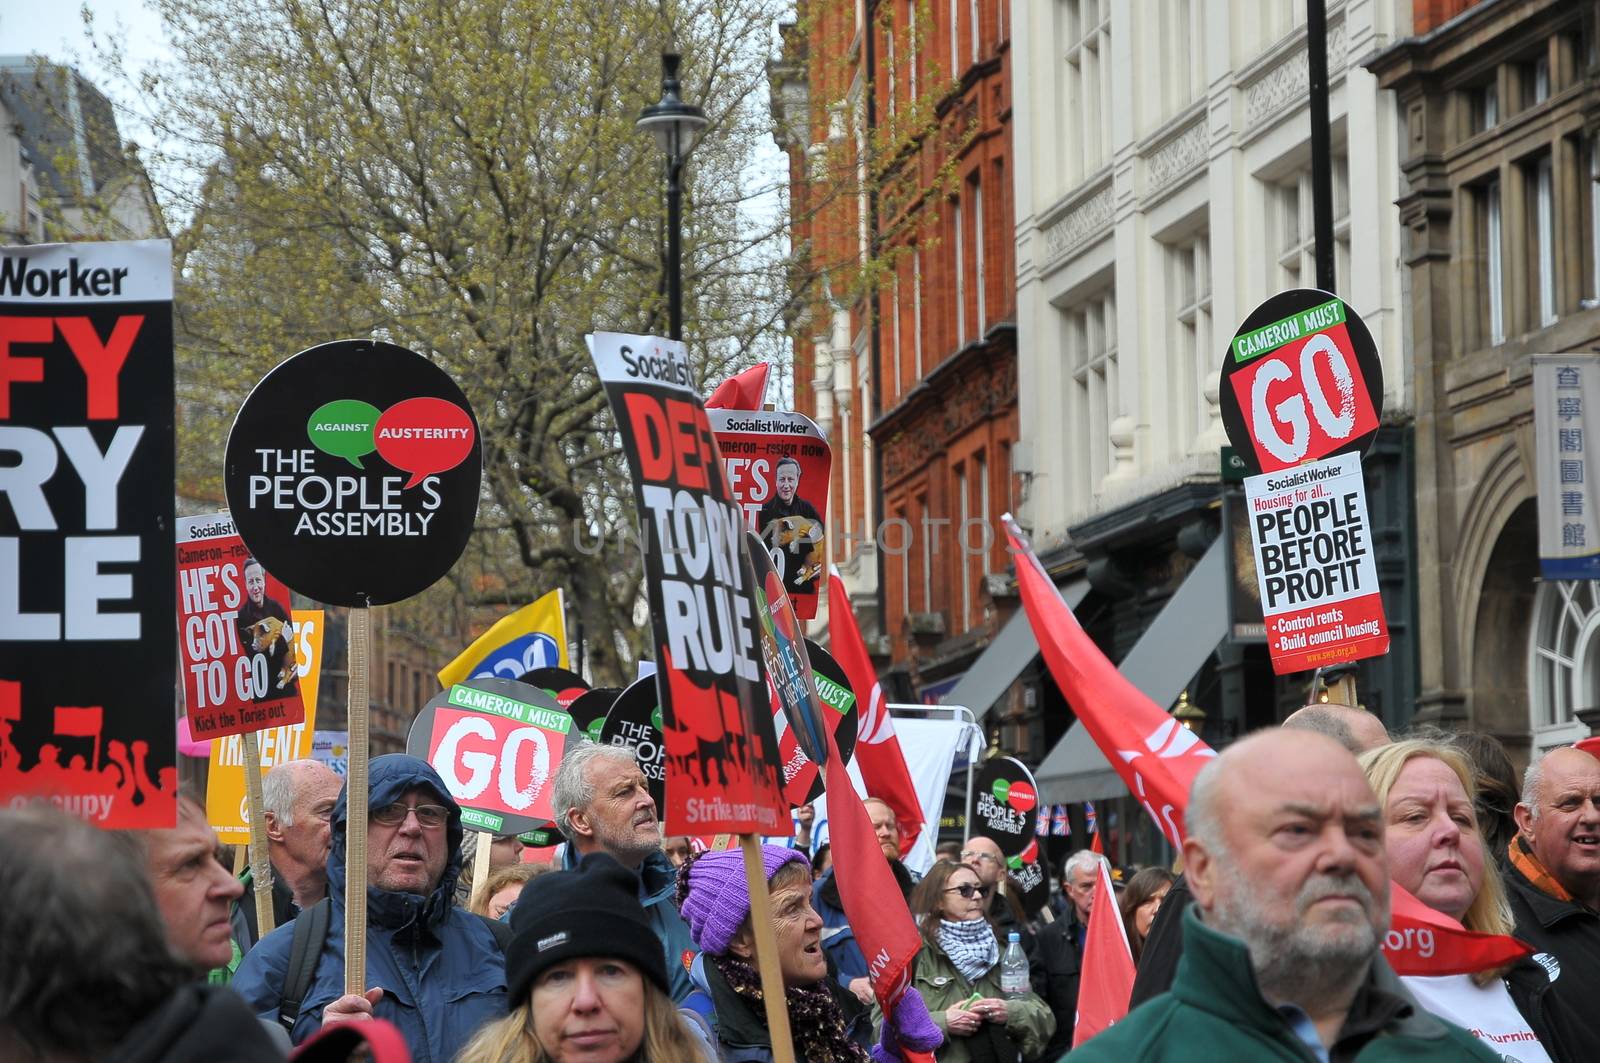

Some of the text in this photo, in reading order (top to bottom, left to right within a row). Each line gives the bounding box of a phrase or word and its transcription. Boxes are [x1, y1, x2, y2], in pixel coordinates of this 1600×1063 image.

[0, 257, 128, 297] Worker
[1238, 303, 1340, 357] CAMERON MUST
[0, 315, 145, 421] FY
[1252, 334, 1356, 463] GO
[314, 422, 369, 433] AGAINST
[379, 427, 469, 440] AUSTERITY
[624, 392, 731, 500] DEF
[256, 449, 315, 473] THE
[801, 442, 825, 457] now
[0, 425, 145, 531] RY
[1254, 494, 1293, 511] Housing
[1295, 489, 1308, 502] for
[1256, 492, 1361, 544] PEOPLE
[294, 512, 435, 536] ASSEMBLY
[642, 485, 742, 590] TORY
[1261, 525, 1365, 576] BEFORE
[0, 536, 141, 640] LE
[180, 563, 241, 614] HE'S
[1265, 559, 1360, 608] PROFIT
[185, 611, 239, 662] GOT
[661, 580, 760, 682] RULE
[1277, 613, 1315, 633] Control
[1317, 608, 1343, 624] rents
[1280, 619, 1380, 651] Build council housing
[191, 653, 269, 708] TO GO
[814, 675, 851, 708] MUST
[194, 704, 286, 732] Kick the Tories out
[455, 689, 568, 731] CAMERON MUST
[620, 720, 653, 740] THE
[433, 716, 550, 810] GO
[980, 792, 995, 804] THE
[461, 810, 500, 828] ORIES OUT
[987, 818, 1024, 834] ASSEMBLY
[1380, 925, 1435, 958] .org
